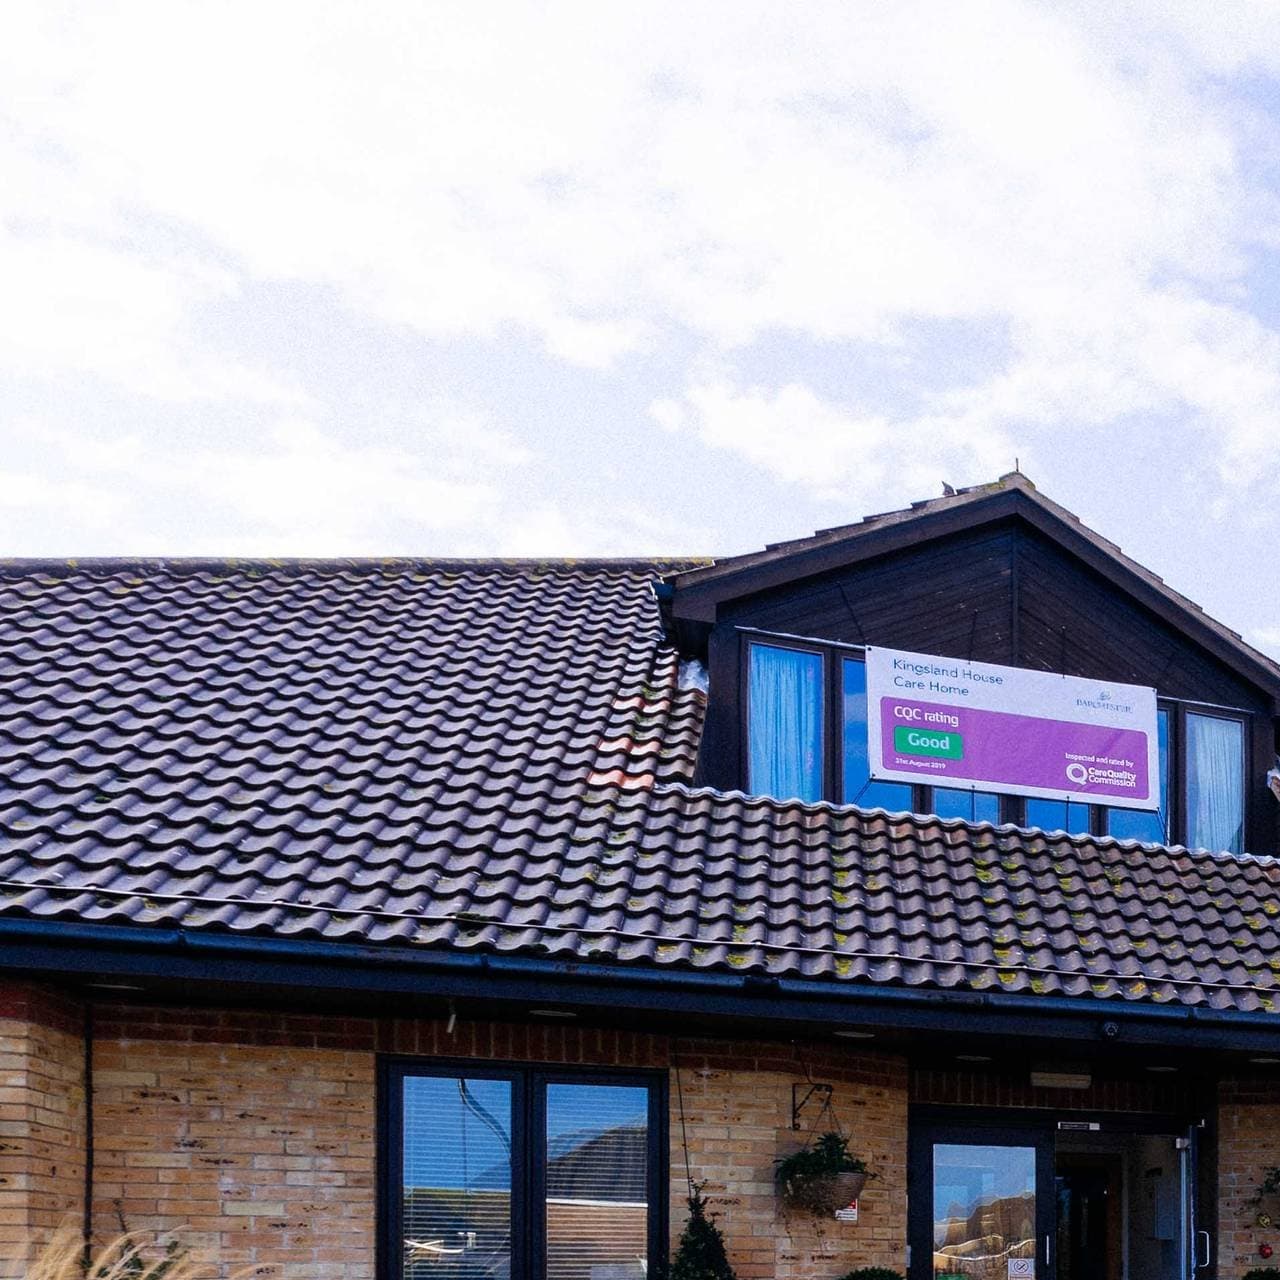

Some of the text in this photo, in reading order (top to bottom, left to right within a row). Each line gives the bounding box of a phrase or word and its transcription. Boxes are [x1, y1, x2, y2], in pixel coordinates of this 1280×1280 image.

[893, 658, 1004, 685] Kingsland House
[893, 675, 969, 696] Care Home
[894, 705, 959, 728] CQC rating
[908, 732, 950, 750] Good
[1126, 760, 1134, 768] by
[1088, 775, 1136, 787] Commission
